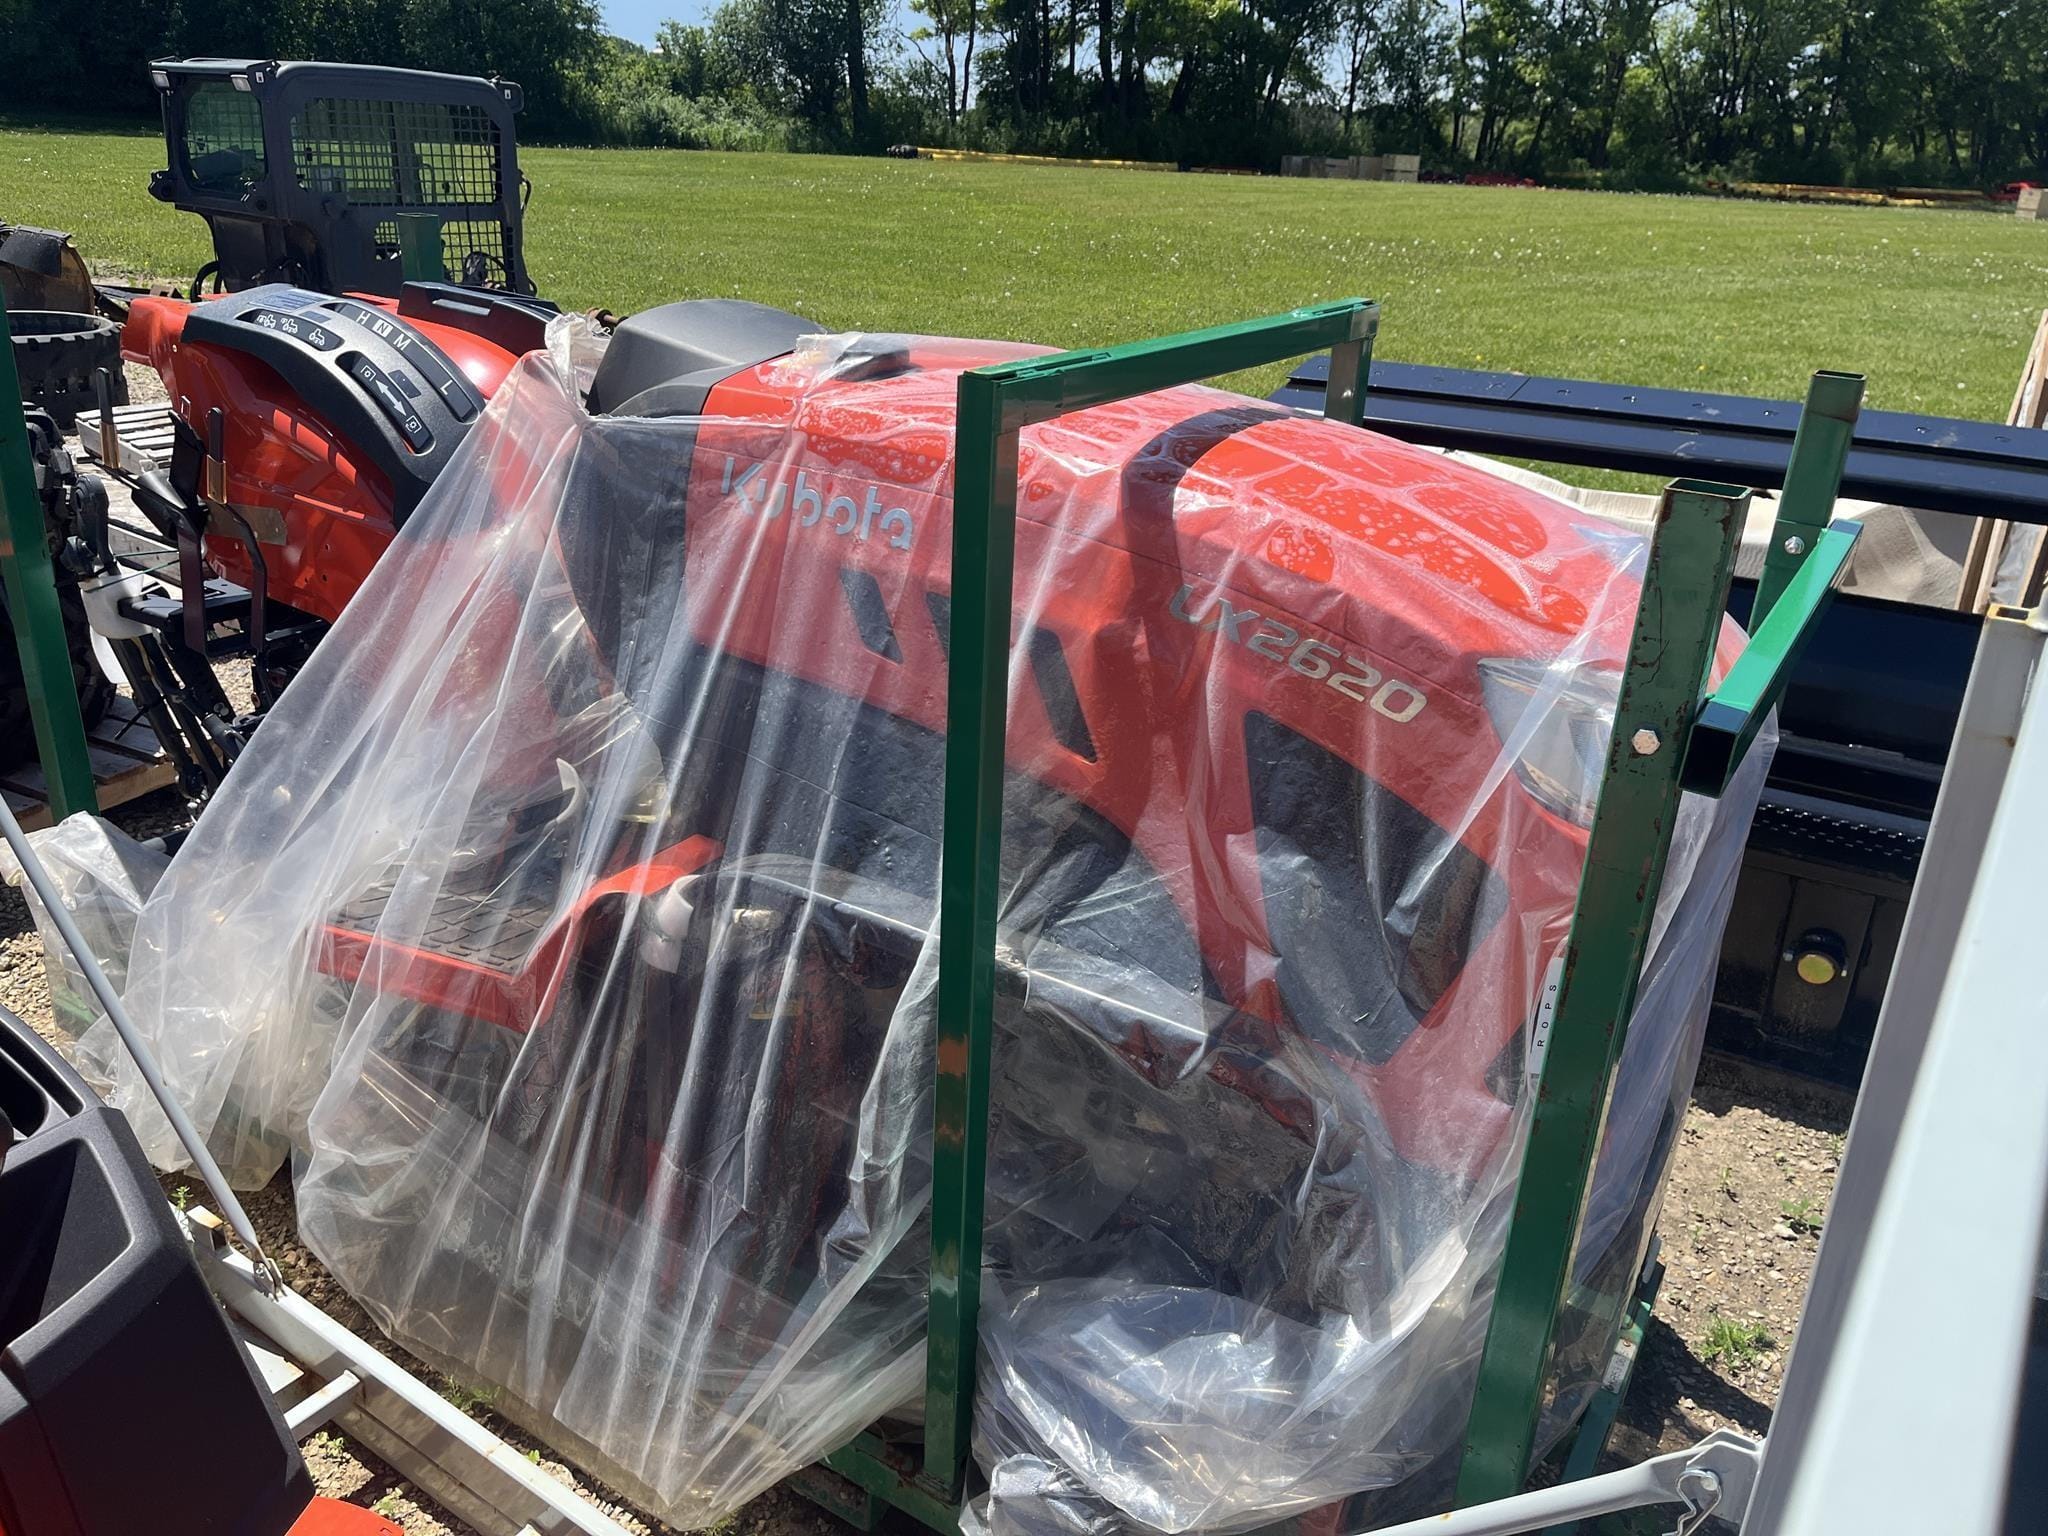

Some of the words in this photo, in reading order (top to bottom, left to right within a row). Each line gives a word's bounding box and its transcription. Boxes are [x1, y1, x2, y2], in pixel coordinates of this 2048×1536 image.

[356, 310, 371, 325] H
[393, 333, 411, 350] M
[440, 380, 453, 395] L
[720, 457, 914, 550] Kubota
[1169, 583, 1428, 723] LX2620
